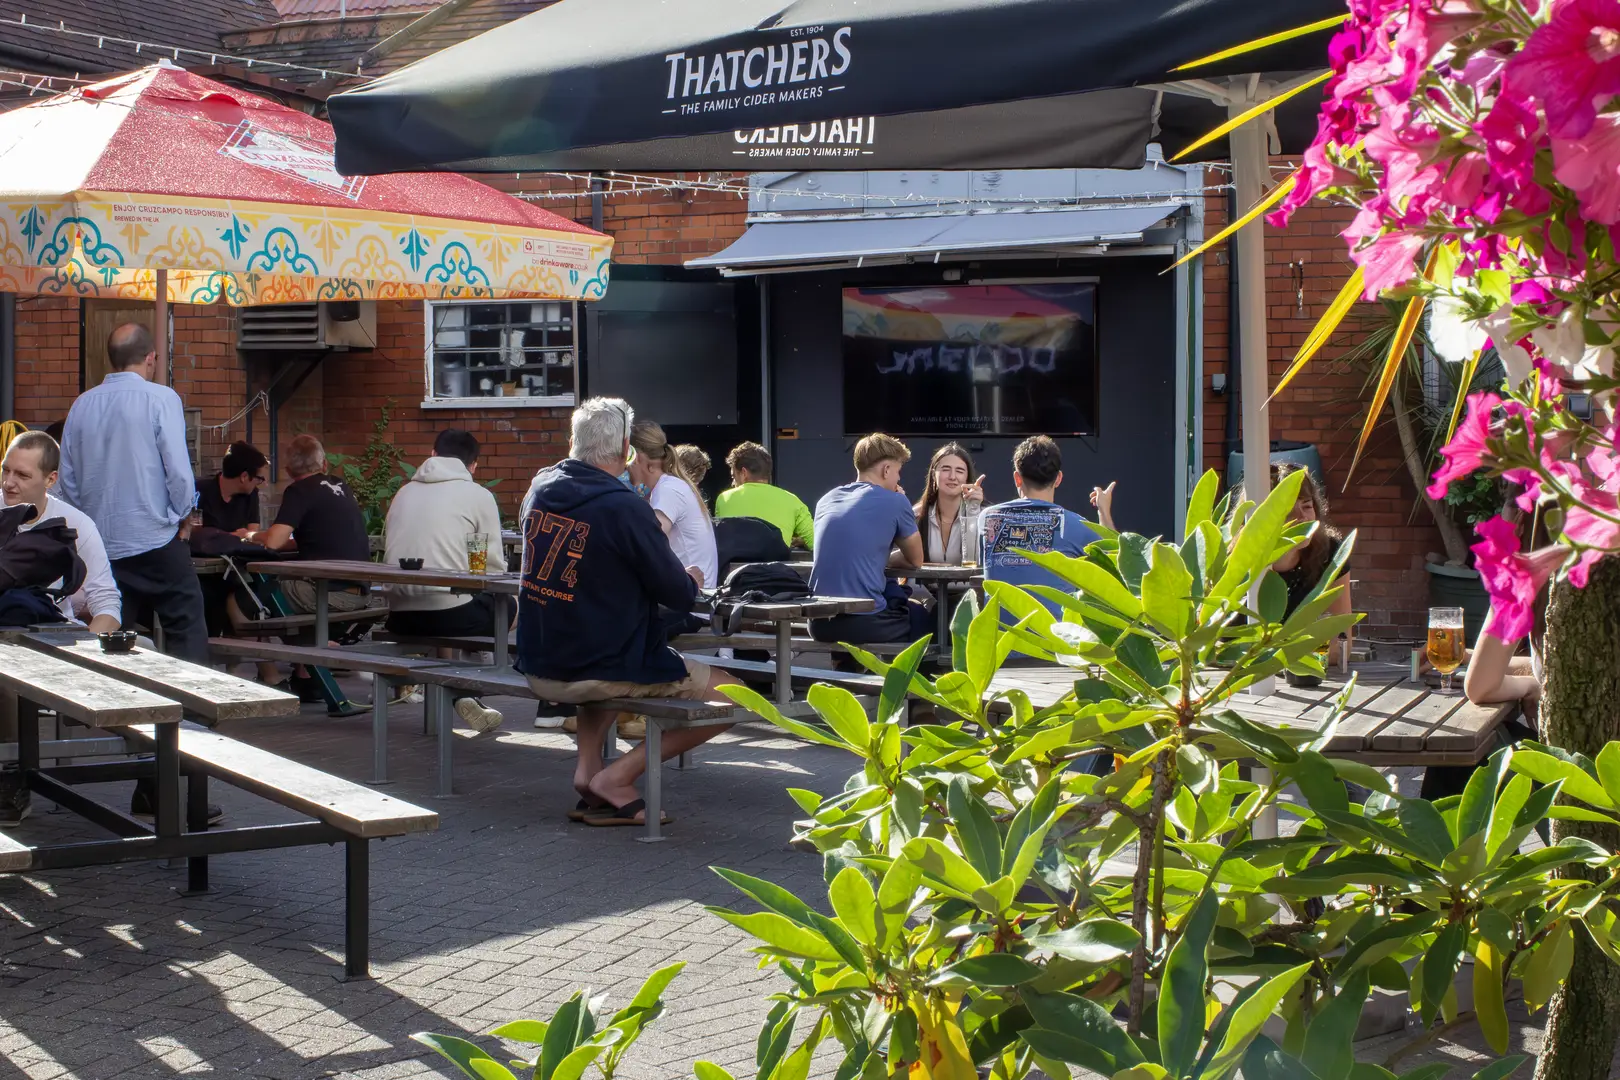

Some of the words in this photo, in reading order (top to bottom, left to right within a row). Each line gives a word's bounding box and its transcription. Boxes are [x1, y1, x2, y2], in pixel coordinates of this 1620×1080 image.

[789, 28, 805, 37] EST.
[806, 25, 824, 34] 1904
[665, 26, 851, 99] THATCHERS
[680, 102, 700, 115] THE
[703, 98, 741, 112] FAMILY
[743, 93, 775, 107] CIDER
[778, 86, 823, 103] MAKERS
[113, 204, 137, 212] ENJOY
[138, 205, 183, 215] CRUZCAMPO
[185, 208, 230, 218] RESPONSIBLY
[540, 587, 574, 602] COURSE
